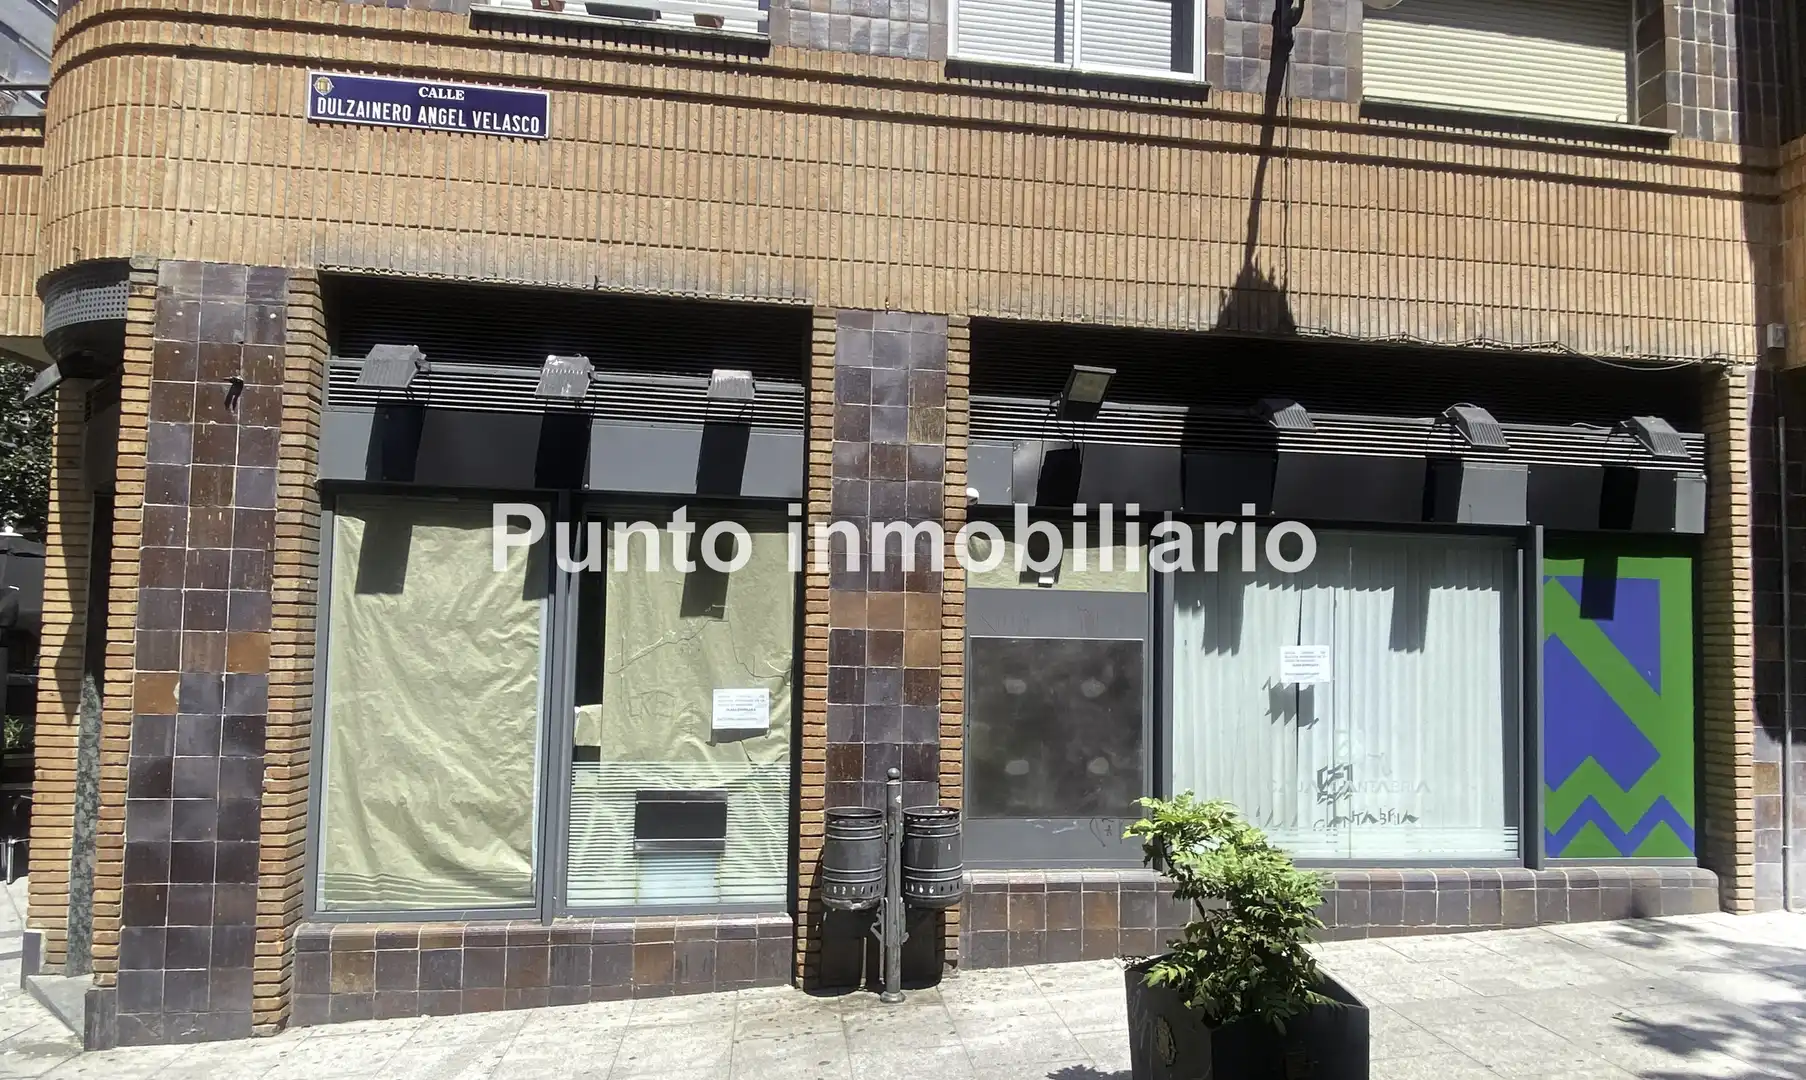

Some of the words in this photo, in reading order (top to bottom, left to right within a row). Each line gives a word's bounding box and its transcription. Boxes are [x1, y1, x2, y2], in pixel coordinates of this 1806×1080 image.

[418, 87, 465, 101] CALLE
[317, 97, 412, 122] DULZAINERO
[418, 105, 467, 127] ANGEL
[472, 111, 540, 133] VELASCO
